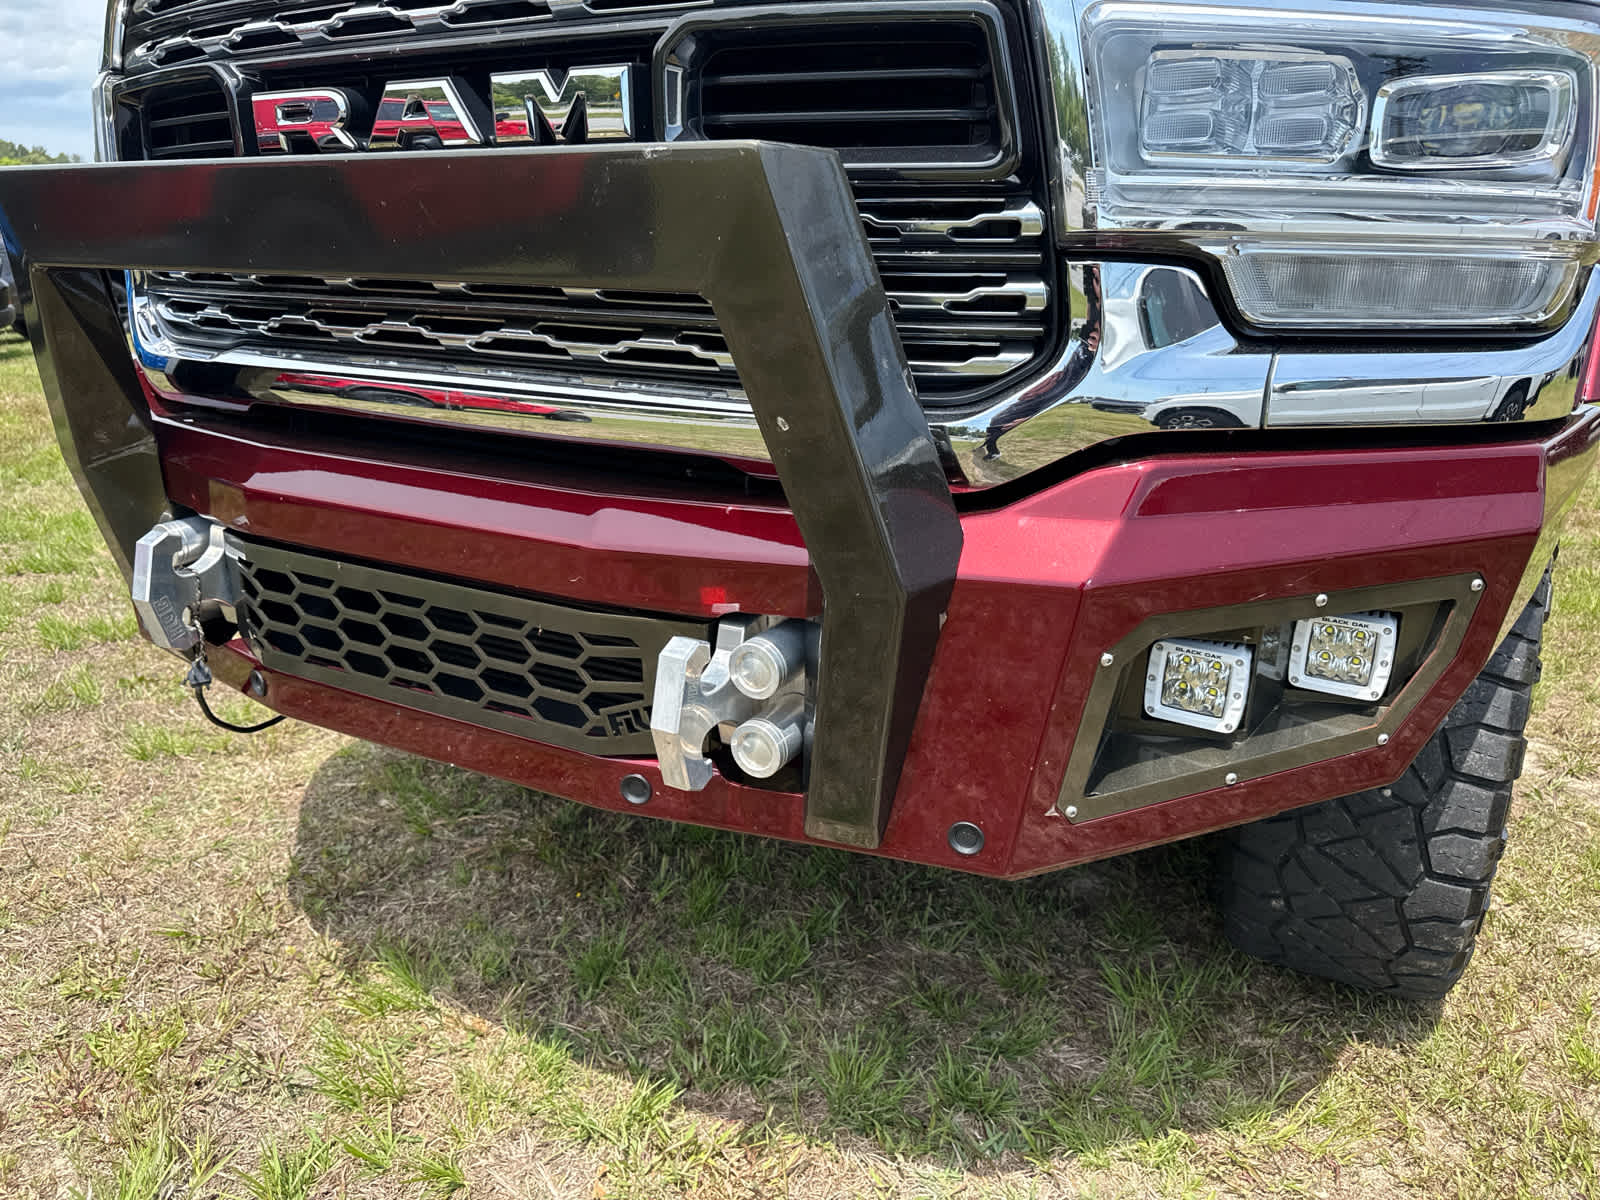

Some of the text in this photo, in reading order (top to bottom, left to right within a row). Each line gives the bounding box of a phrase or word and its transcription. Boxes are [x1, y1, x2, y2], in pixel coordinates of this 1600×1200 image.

[252, 64, 633, 152] RAM
[1322, 616, 1370, 629] BLACK OAK
[1175, 646, 1222, 660] BLACK OAK
